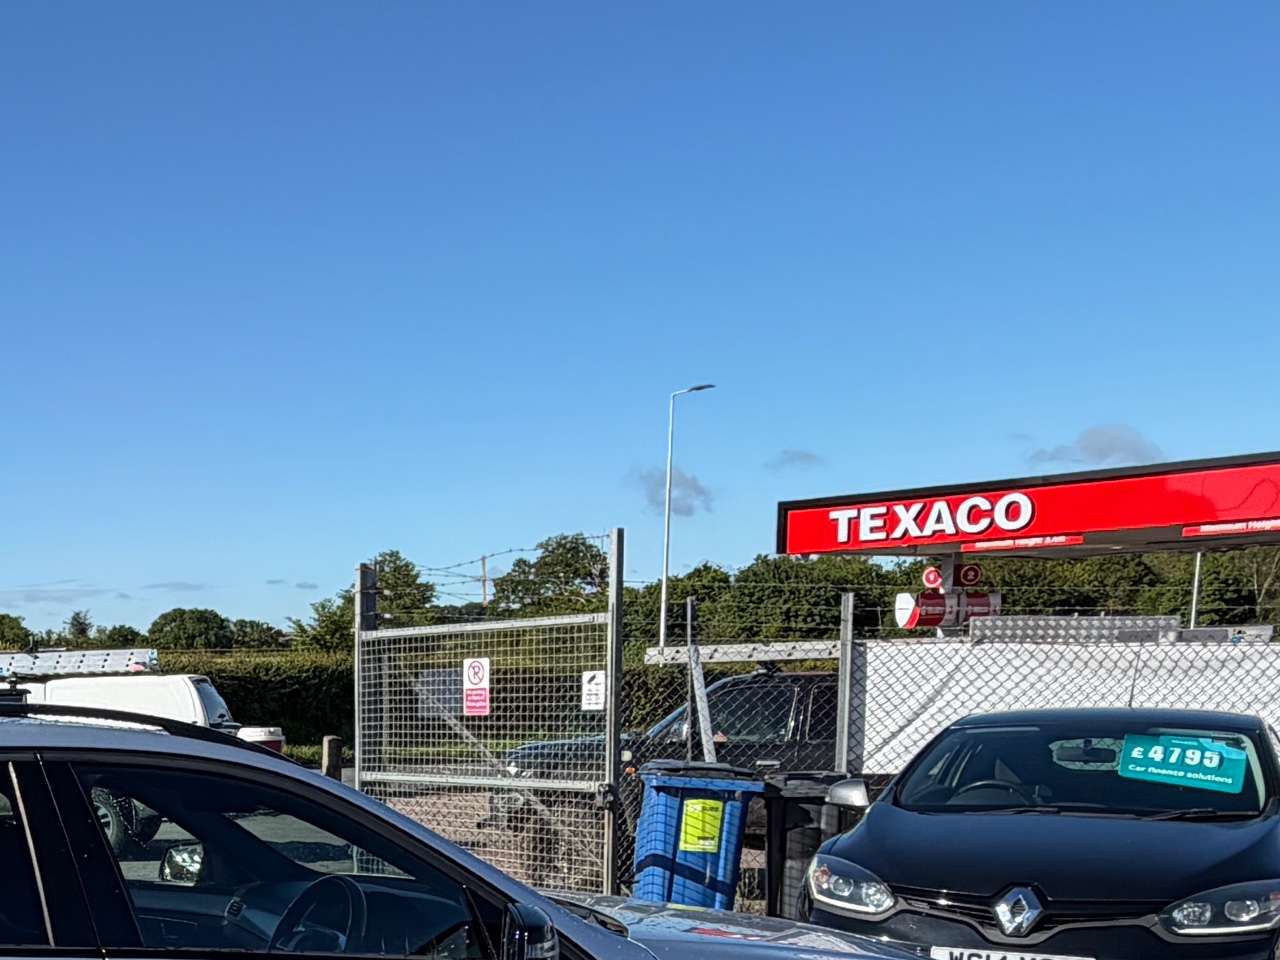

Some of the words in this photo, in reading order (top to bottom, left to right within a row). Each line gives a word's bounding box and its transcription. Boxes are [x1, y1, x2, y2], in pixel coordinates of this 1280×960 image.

[829, 492, 1033, 543] TEXACO
[1130, 745, 1222, 768] £4795
[1128, 764, 1147, 772] Car
[1186, 771, 1233, 785] solutions
